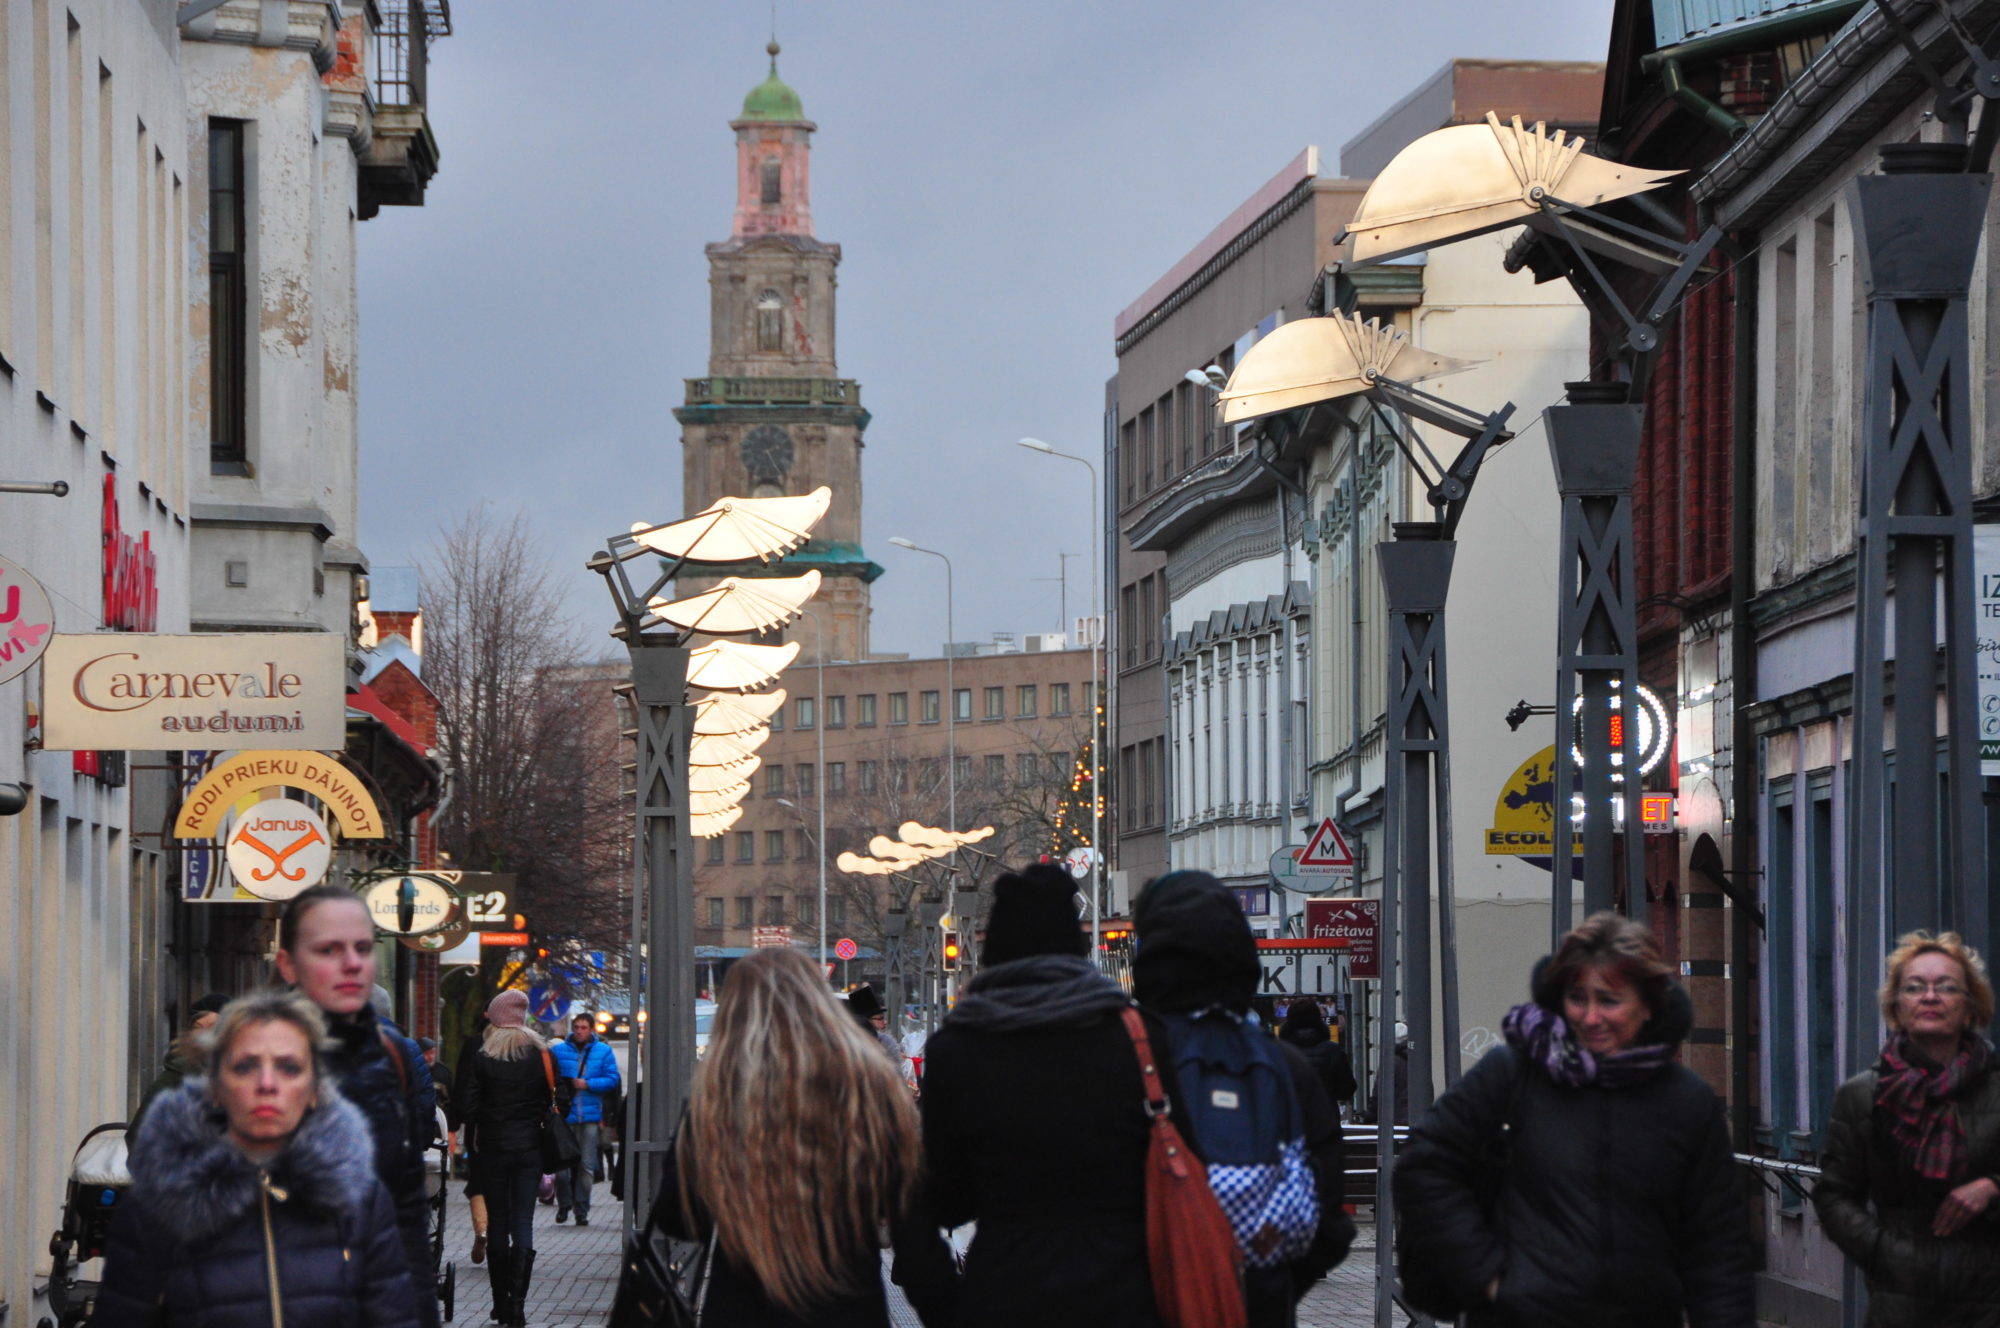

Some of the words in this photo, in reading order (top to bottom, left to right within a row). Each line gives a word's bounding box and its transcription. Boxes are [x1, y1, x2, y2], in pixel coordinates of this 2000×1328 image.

[73, 652, 302, 712] Carnevale
[161, 709, 305, 732] audumi
[185, 784, 223, 830] RODI
[222, 760, 298, 788] PRIEKU
[304, 765, 371, 833] DĀVINOT
[250, 817, 306, 831] Janus
[1321, 841, 1335, 857] M
[375, 900, 440, 914] Loards
[1313, 925, 1373, 939] frizētava
